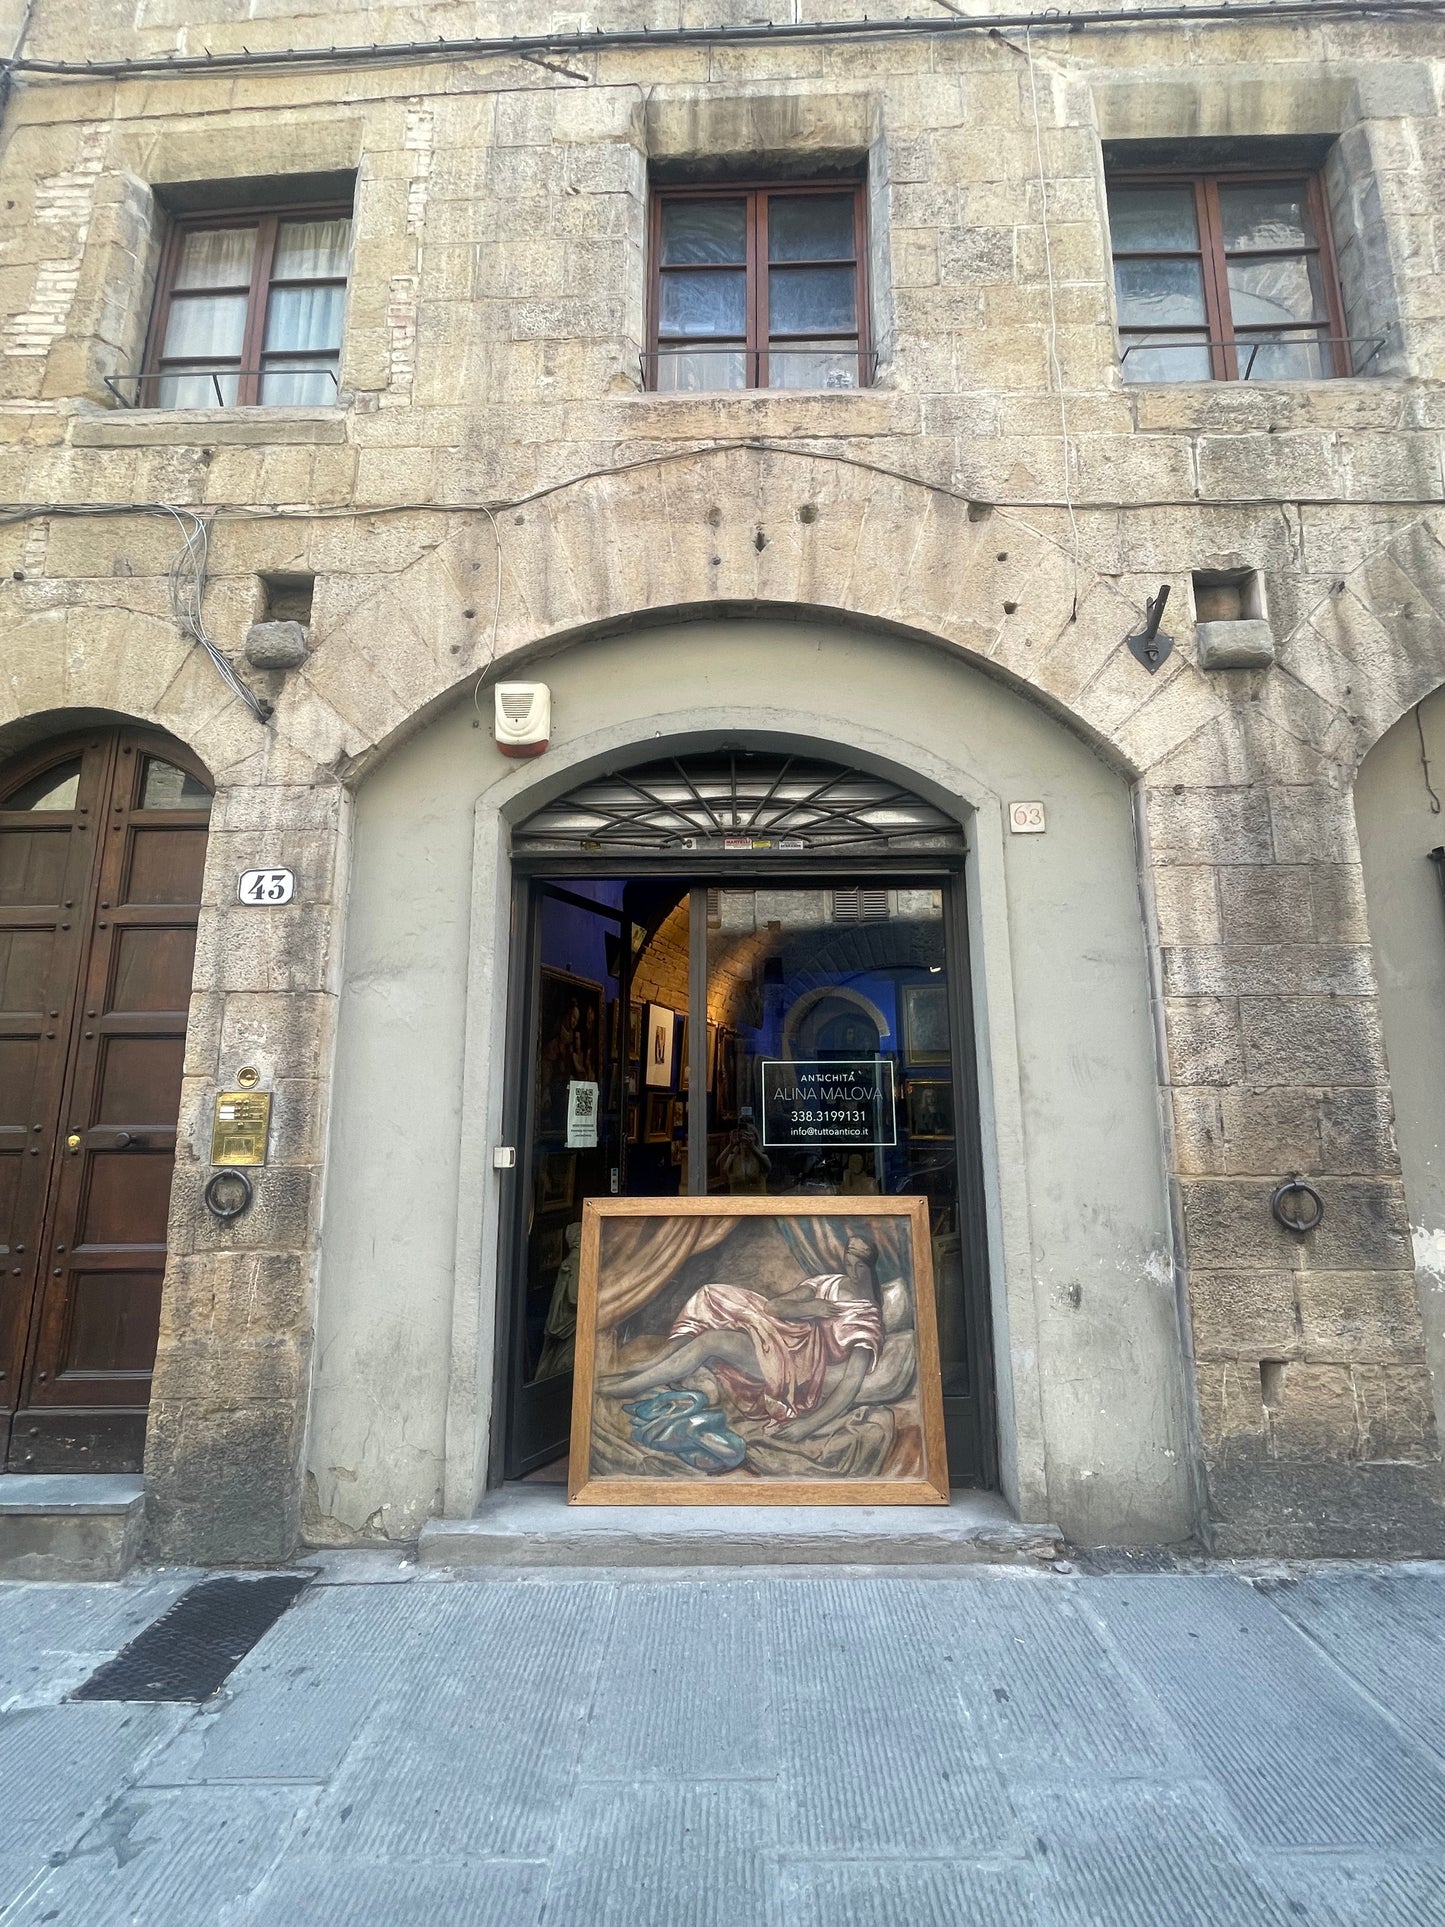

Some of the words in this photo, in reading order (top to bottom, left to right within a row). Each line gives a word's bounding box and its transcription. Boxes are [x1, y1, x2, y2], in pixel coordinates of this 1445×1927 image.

[1014, 805, 1041, 825] 63
[248, 875, 286, 900] 43
[774, 1087, 817, 1100] ALINA
[820, 1087, 883, 1100] MALOVA
[791, 1110, 866, 1122] 338.3199131
[790, 1126, 869, 1136] info@tuttoantico.it
